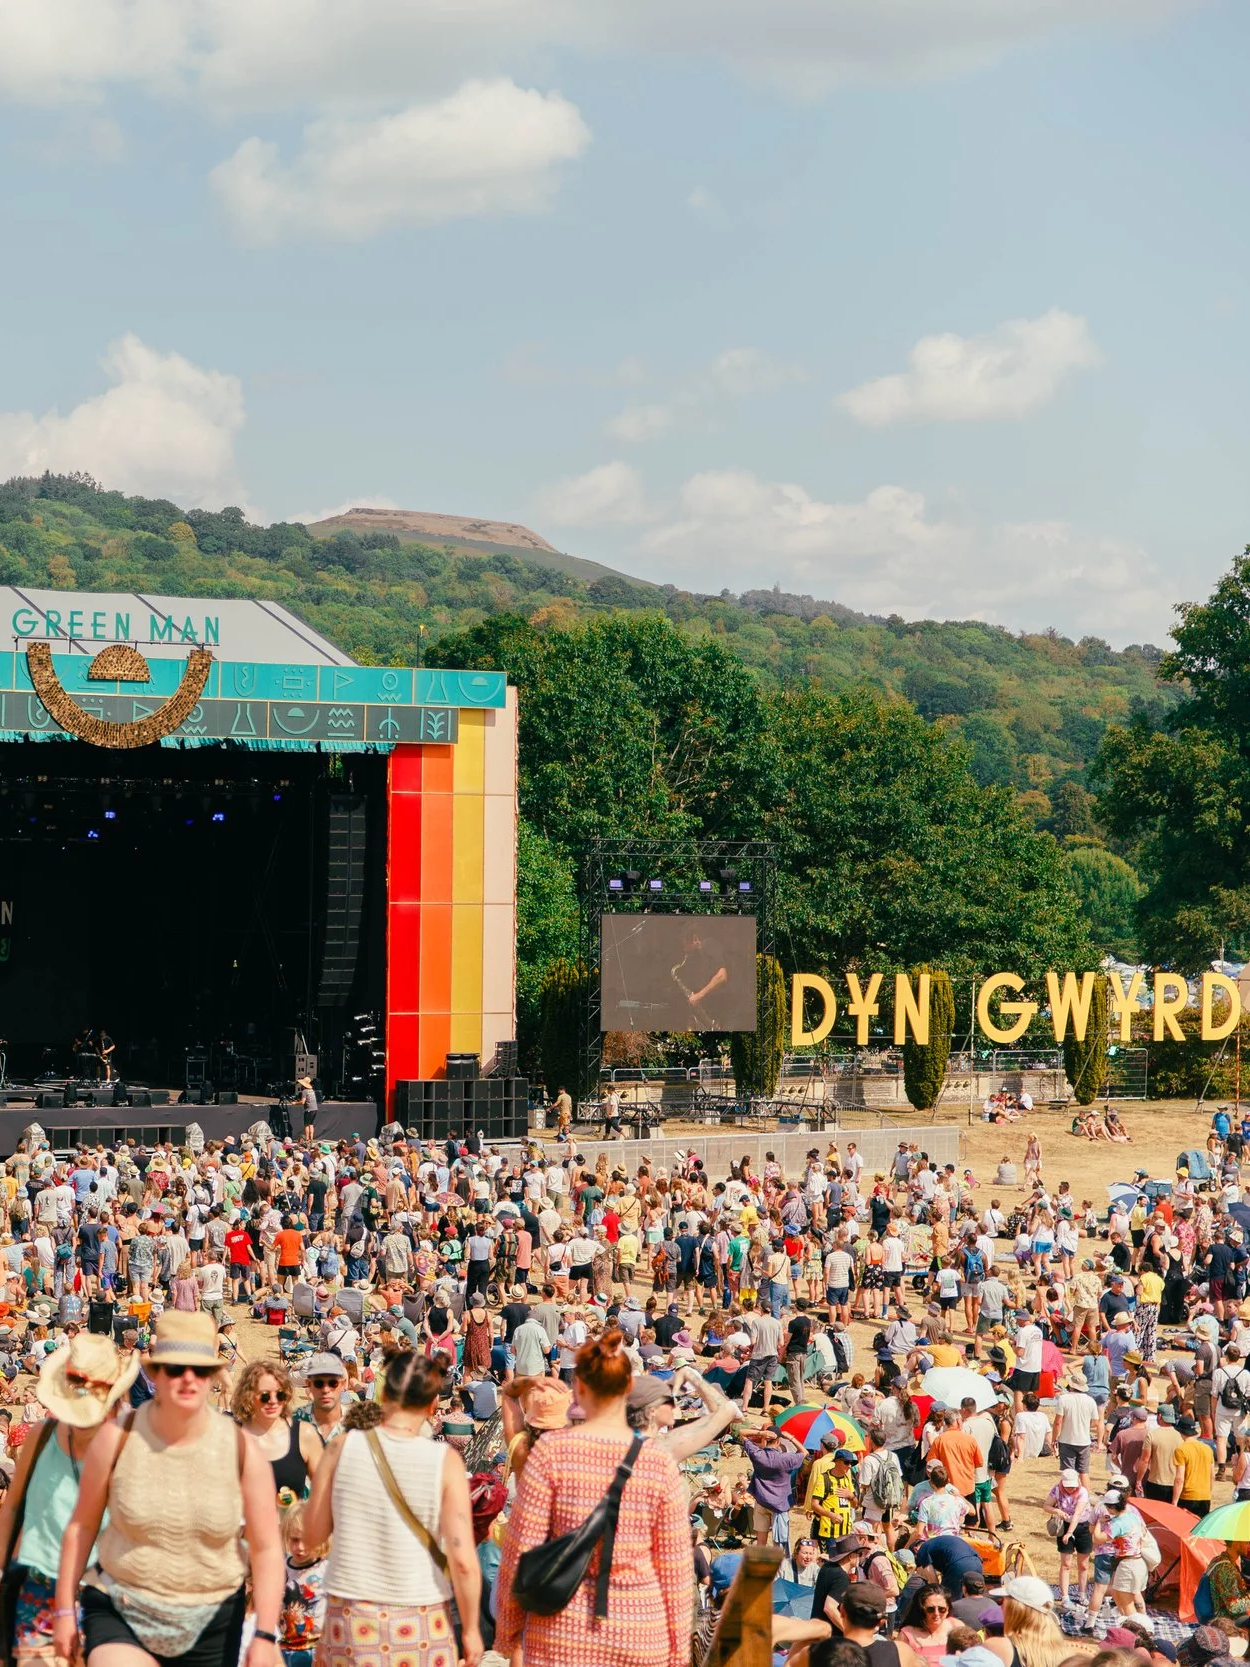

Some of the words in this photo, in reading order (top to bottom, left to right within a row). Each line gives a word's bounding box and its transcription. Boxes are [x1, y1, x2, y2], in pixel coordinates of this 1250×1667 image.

[11, 608, 131, 640] GREEN
[150, 613, 220, 643] MAN
[791, 973, 930, 1046] DYN
[977, 971, 1241, 1043] GWYRD
